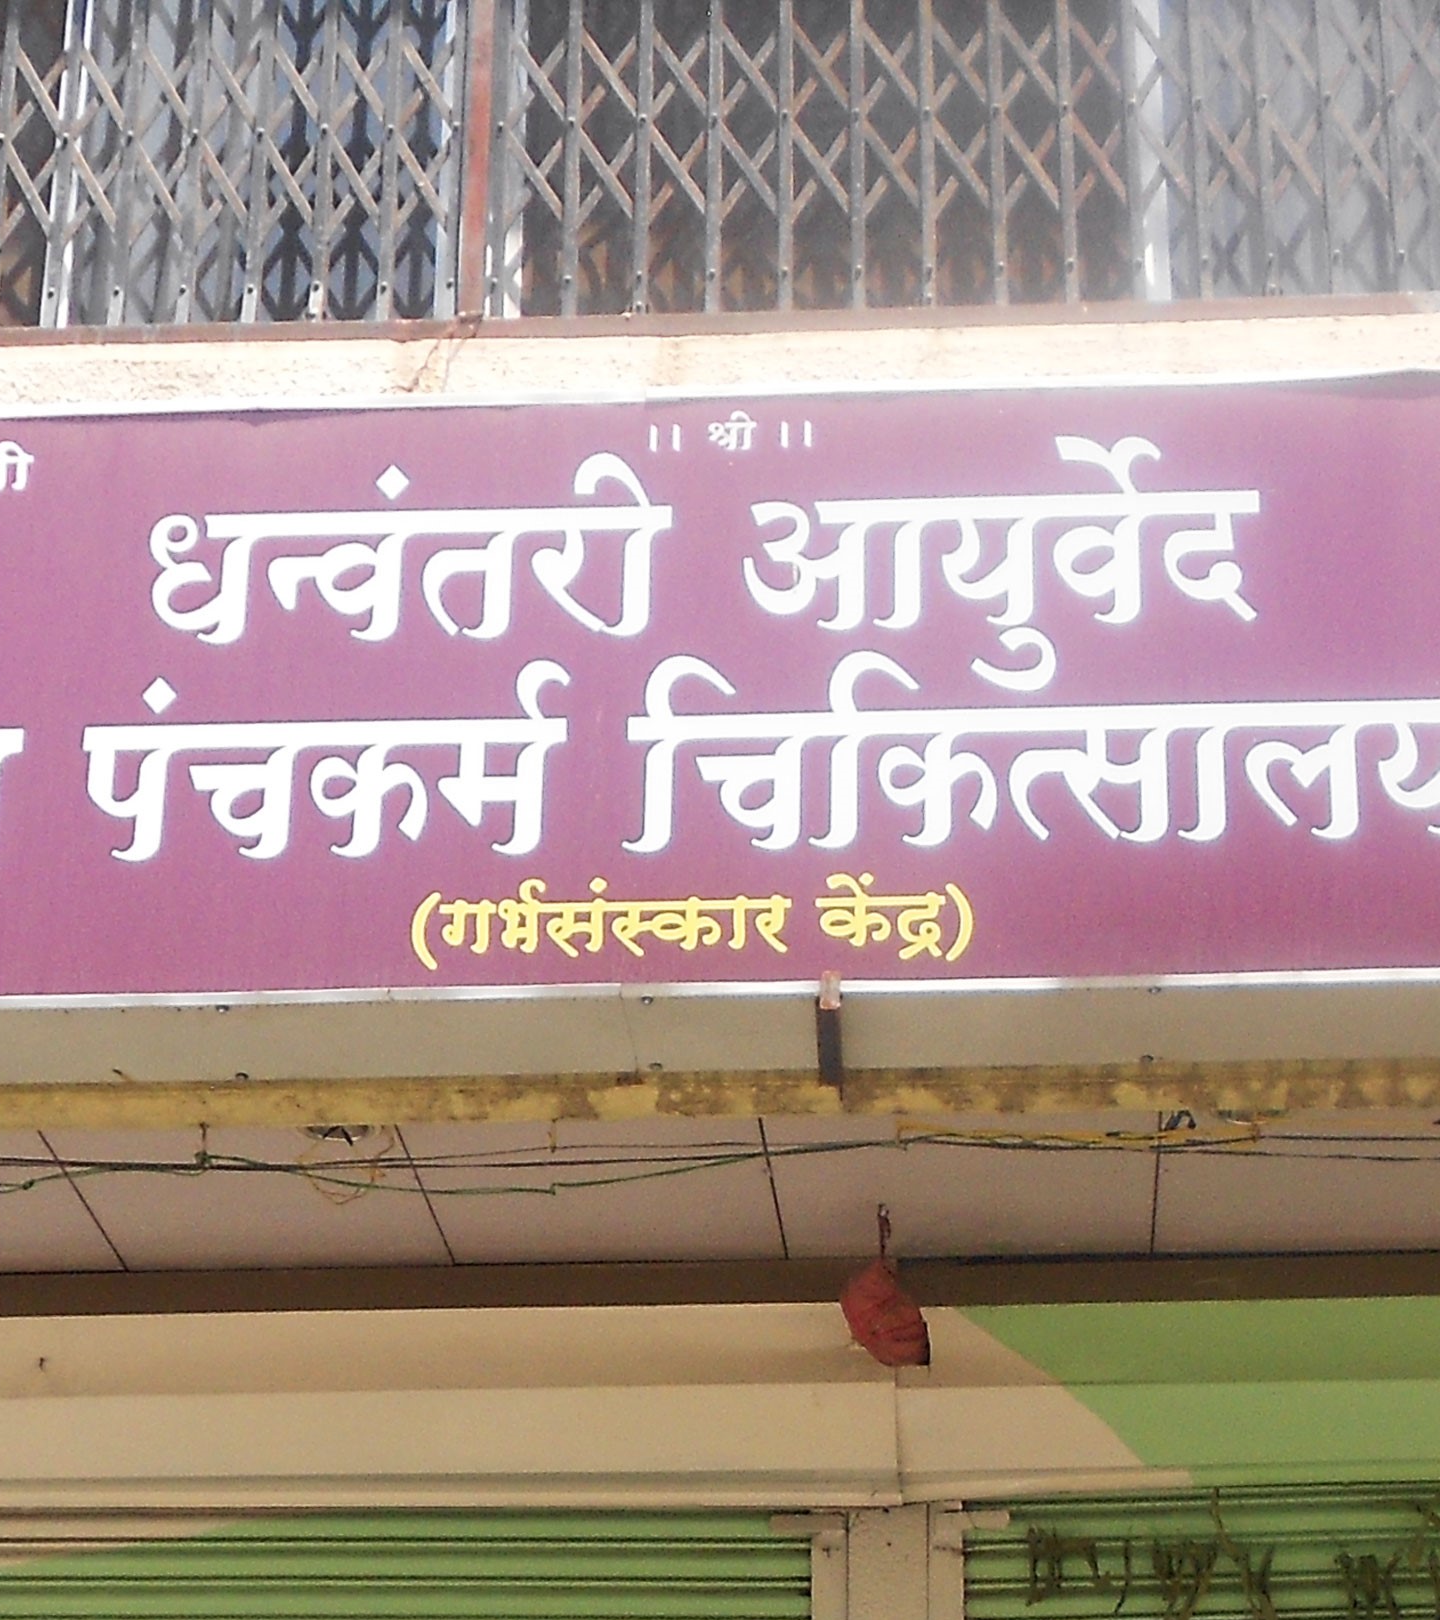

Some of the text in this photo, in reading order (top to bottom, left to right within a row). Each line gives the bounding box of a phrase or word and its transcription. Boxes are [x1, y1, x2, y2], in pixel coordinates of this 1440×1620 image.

[708, 408, 759, 454] श्री
[149, 434, 1261, 686] धन्वंतरी आयुर्वेद
[80, 661, 570, 861] पंचकर्म
[410, 874, 976, 972] (गर्भसंस्कार केंद्र)
